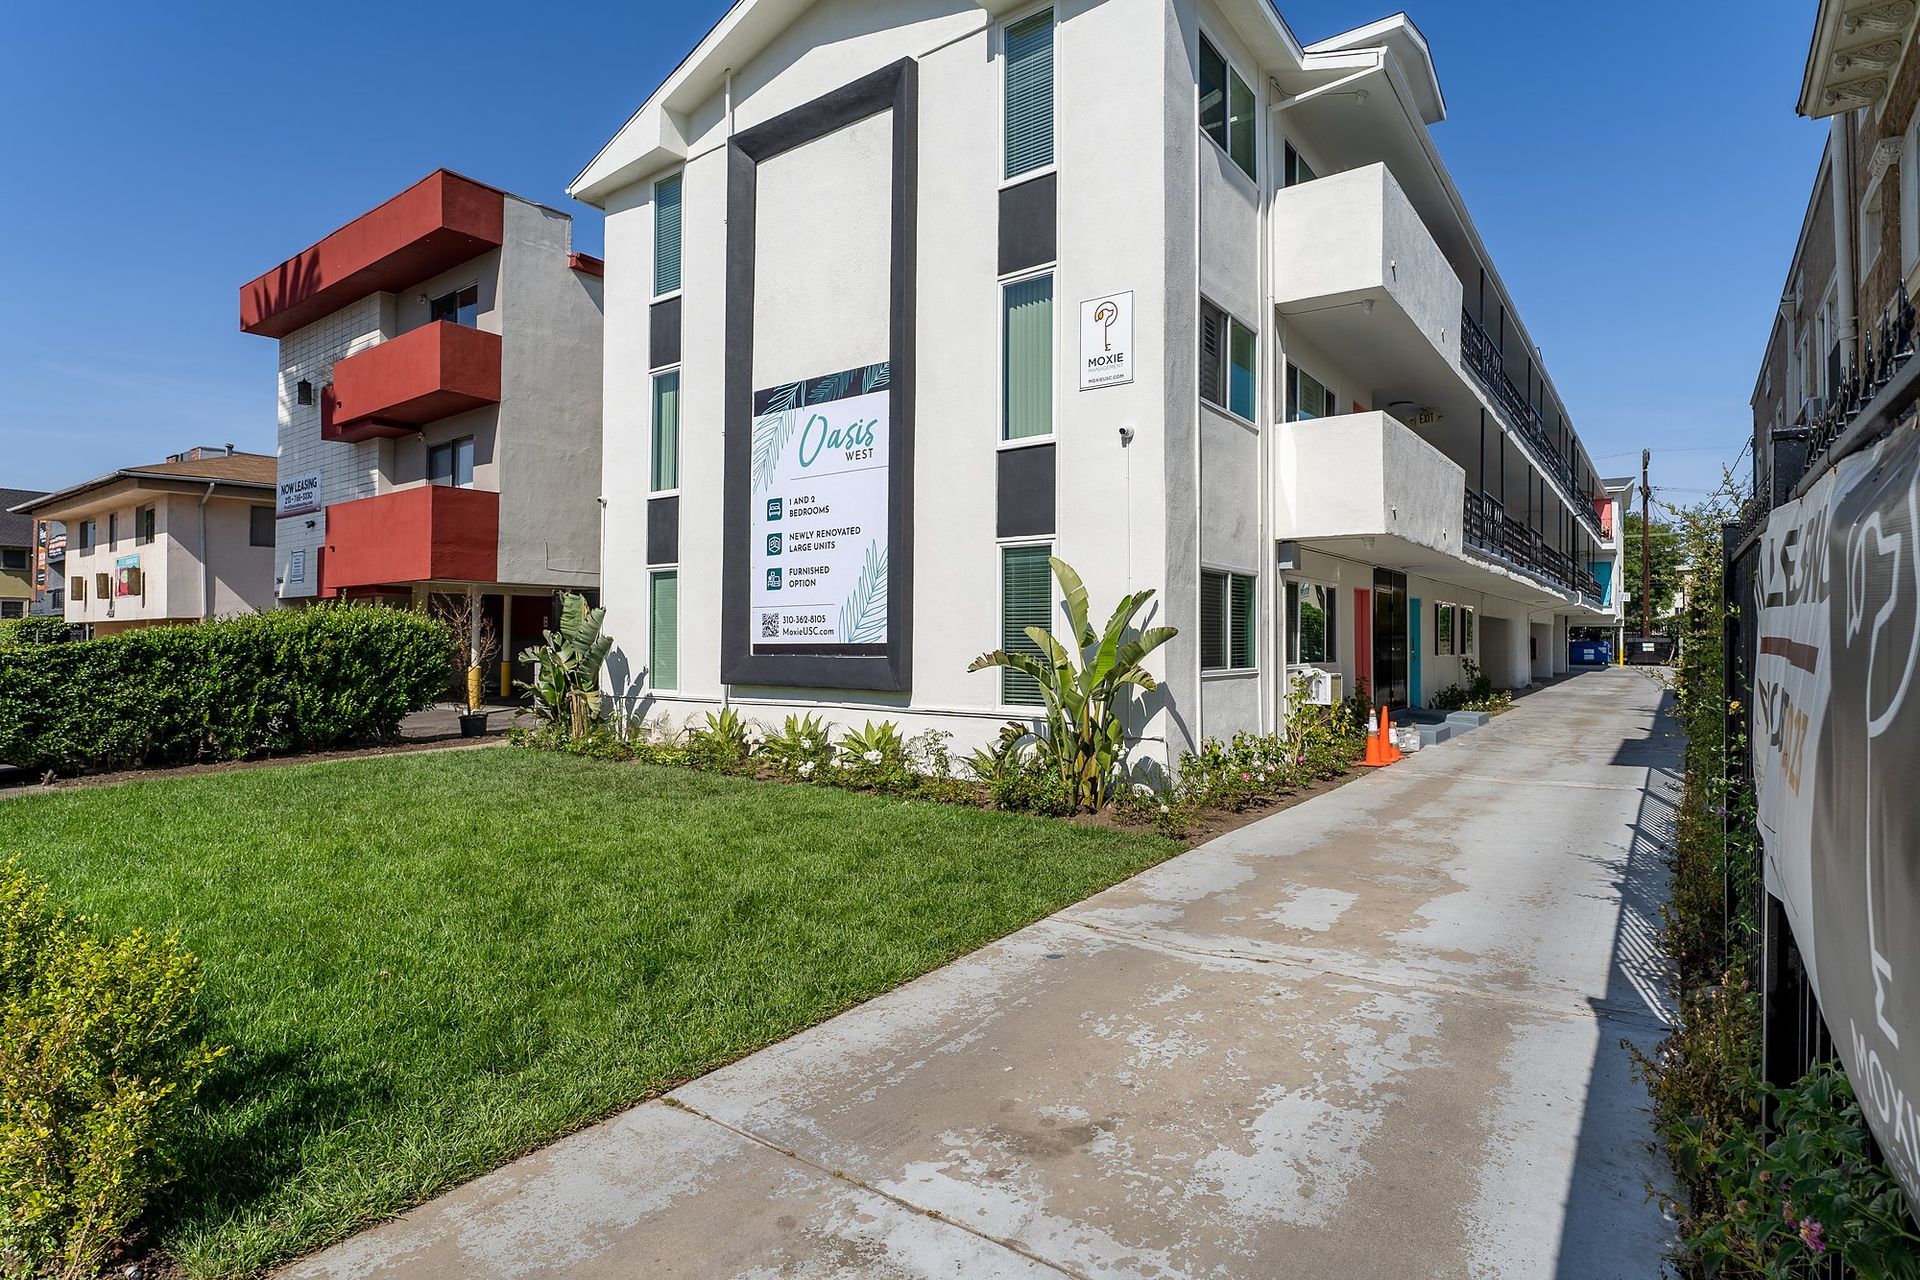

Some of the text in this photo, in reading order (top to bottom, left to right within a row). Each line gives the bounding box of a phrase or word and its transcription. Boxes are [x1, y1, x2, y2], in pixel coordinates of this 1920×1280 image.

[1088, 352, 1124, 368] MOXIE
[1419, 412, 1434, 424] EXIT
[799, 413, 878, 468] Oasis
[845, 448, 874, 461] WEST
[281, 477, 318, 496] NOW LEASING
[793, 496, 810, 506] AND
[810, 495, 816, 503] 2
[789, 505, 830, 517] BEDROOMS
[789, 526, 861, 541] NEWLY RENOVATED
[789, 541, 836, 553] LARGE UNITS
[789, 566, 830, 576] FURNISHED
[788, 578, 817, 588] OPTION
[782, 615, 827, 624] 310-362-8105
[782, 626, 835, 637] MoxieUSC.com
